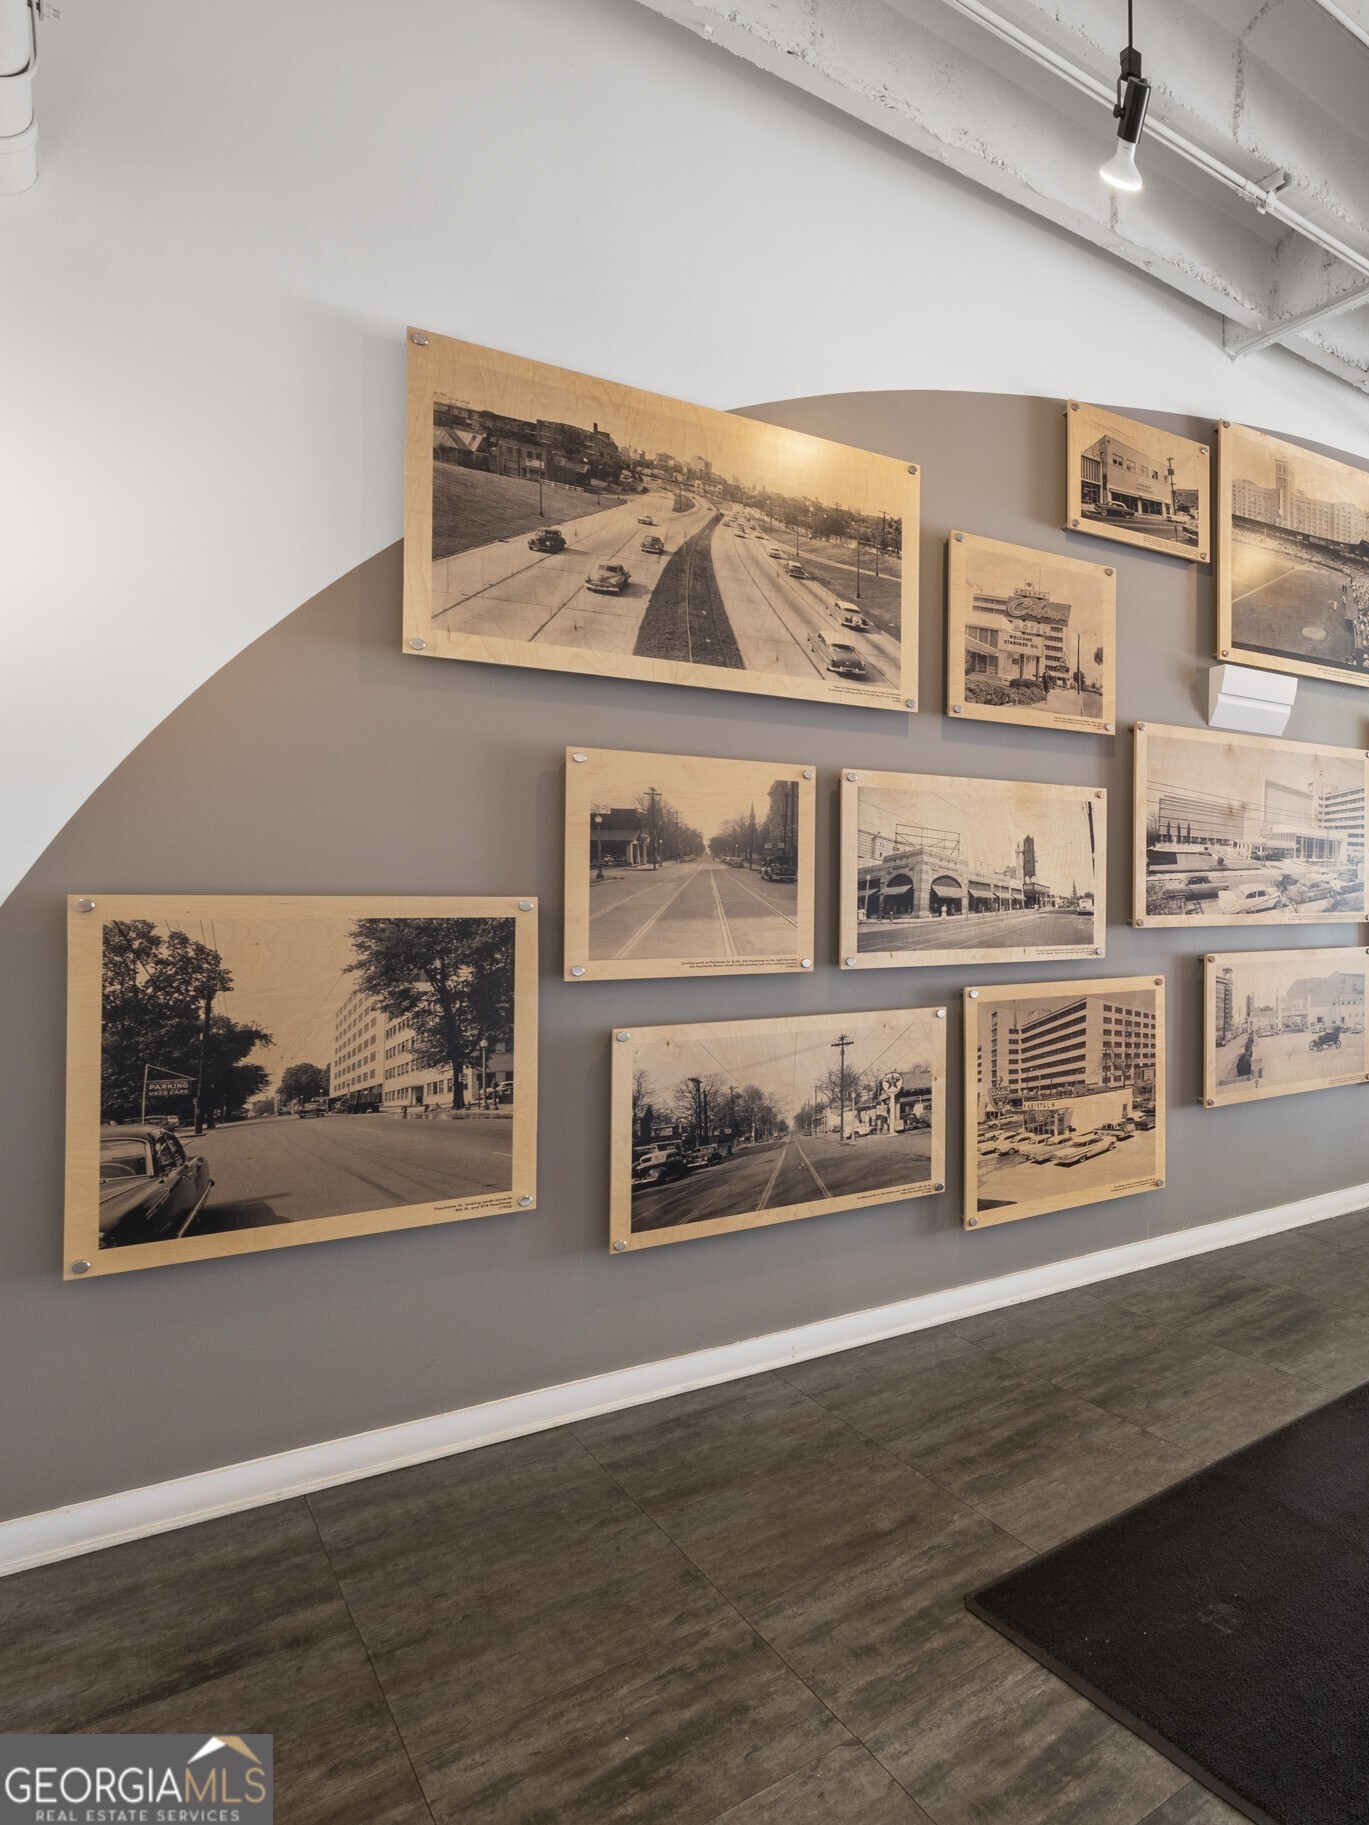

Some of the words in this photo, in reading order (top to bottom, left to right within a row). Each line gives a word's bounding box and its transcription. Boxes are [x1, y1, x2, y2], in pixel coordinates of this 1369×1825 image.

[1008, 598, 1069, 621] Cabana
[1014, 624, 1047, 634] MOTEL
[1004, 640, 1028, 648] STANDARD
